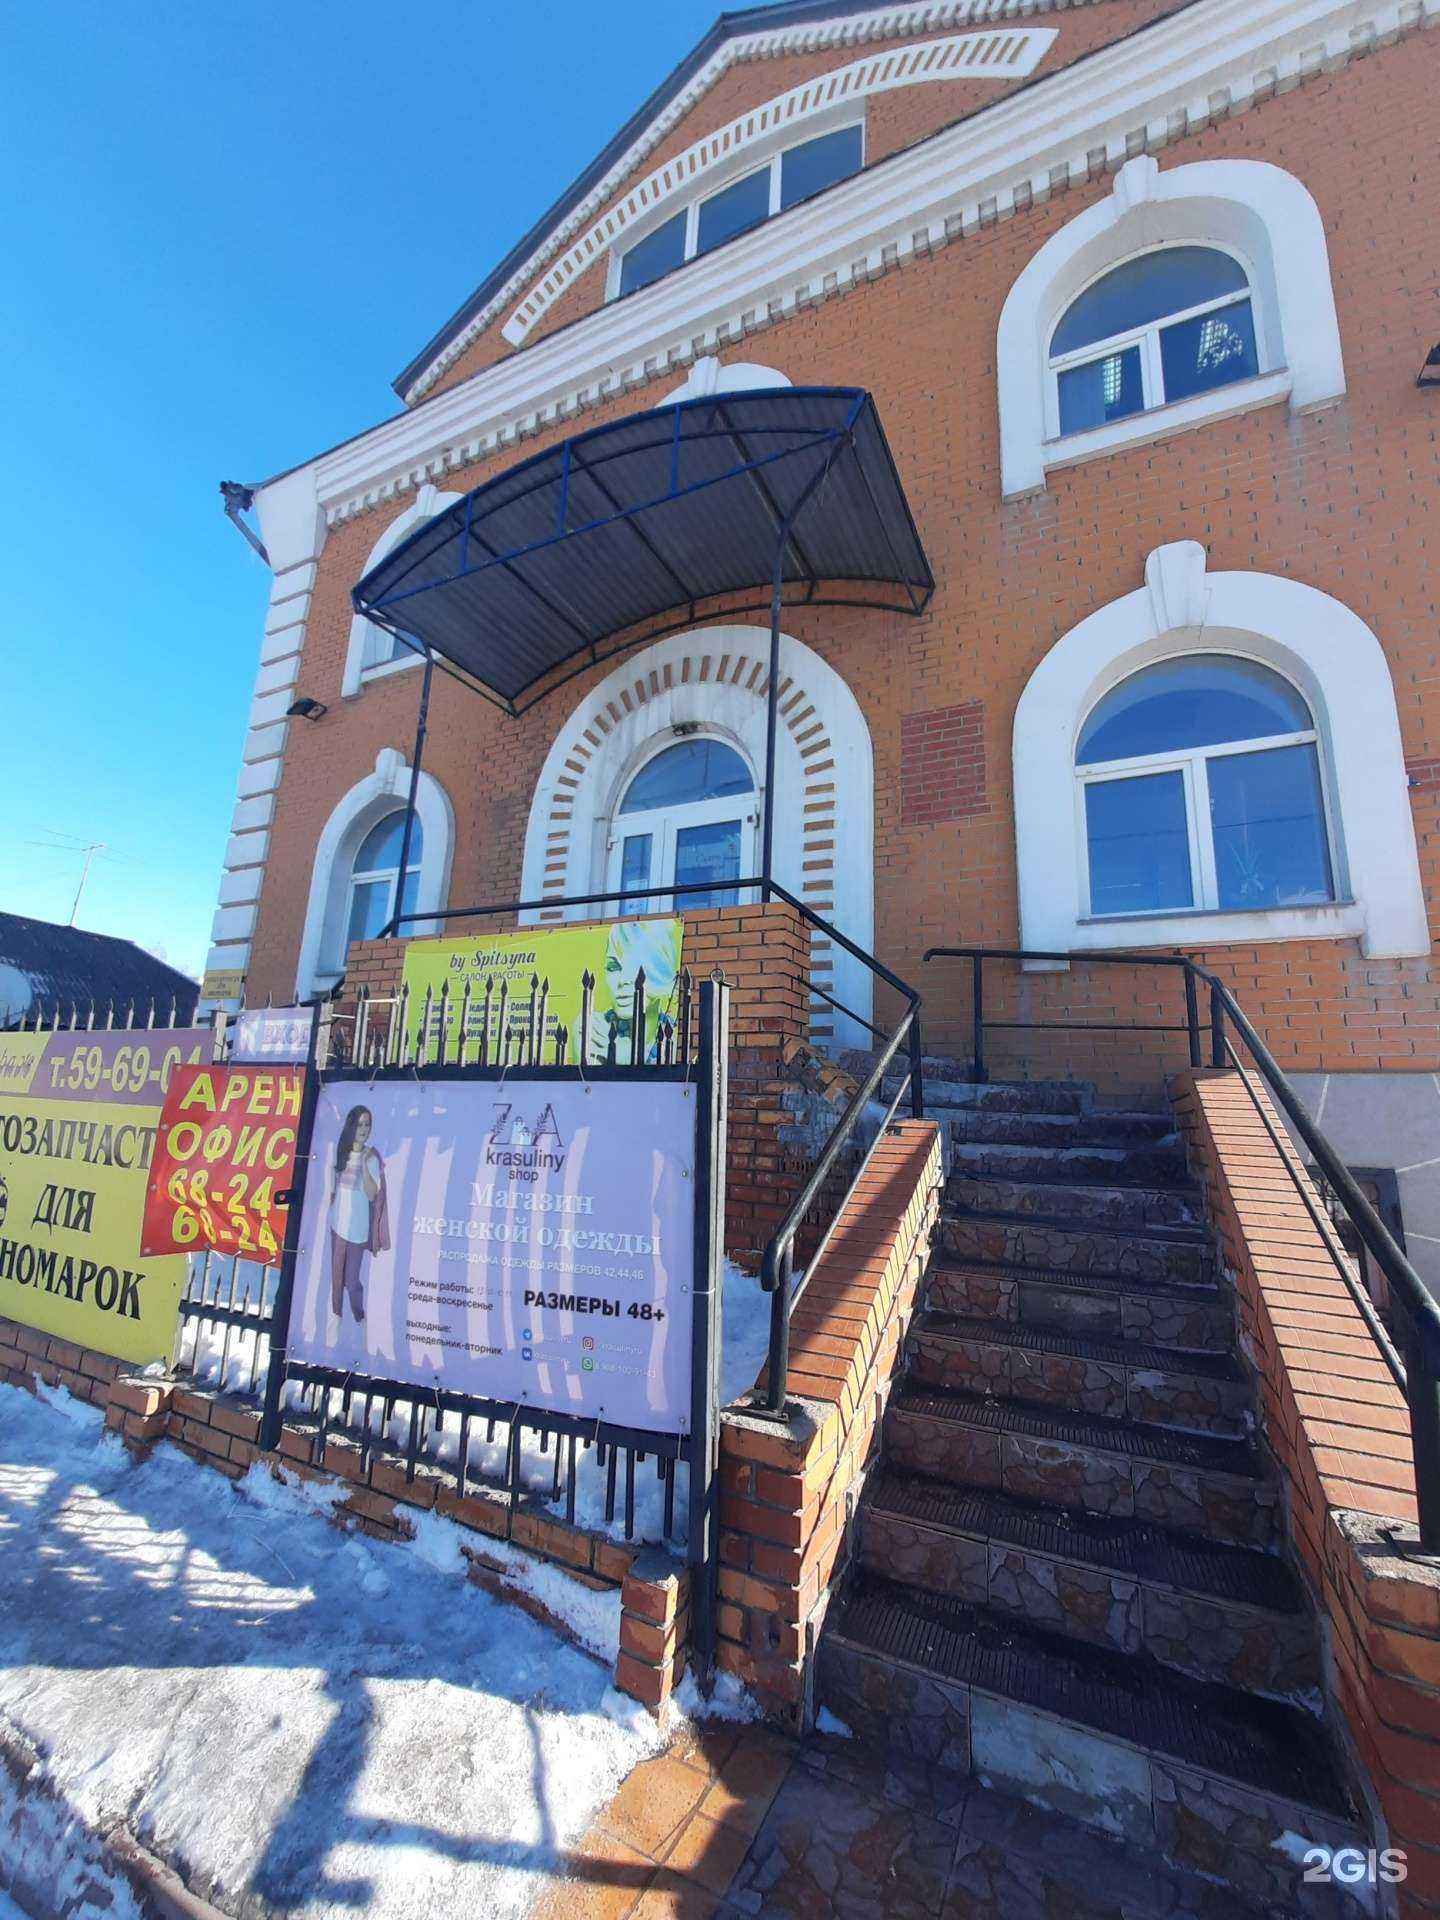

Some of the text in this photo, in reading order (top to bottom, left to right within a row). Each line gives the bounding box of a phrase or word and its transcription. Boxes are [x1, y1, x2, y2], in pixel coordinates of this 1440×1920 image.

[450, 950, 536, 972] by Spitsyna
[179, 1072, 300, 1116] АРЕН
[166, 1121, 295, 1170] ОФИС
[486, 1148, 565, 1173] krasuliny
[508, 1168, 540, 1184] shop
[30, 1184, 96, 1236] ДЛЯ
[468, 1182, 595, 1216] Магазин
[413, 1217, 663, 1257] женской одежды
[409, 1276, 437, 1290] Режим
[524, 1290, 620, 1318] РАЗМЕРЫ
[627, 1302, 665, 1322] 48+
